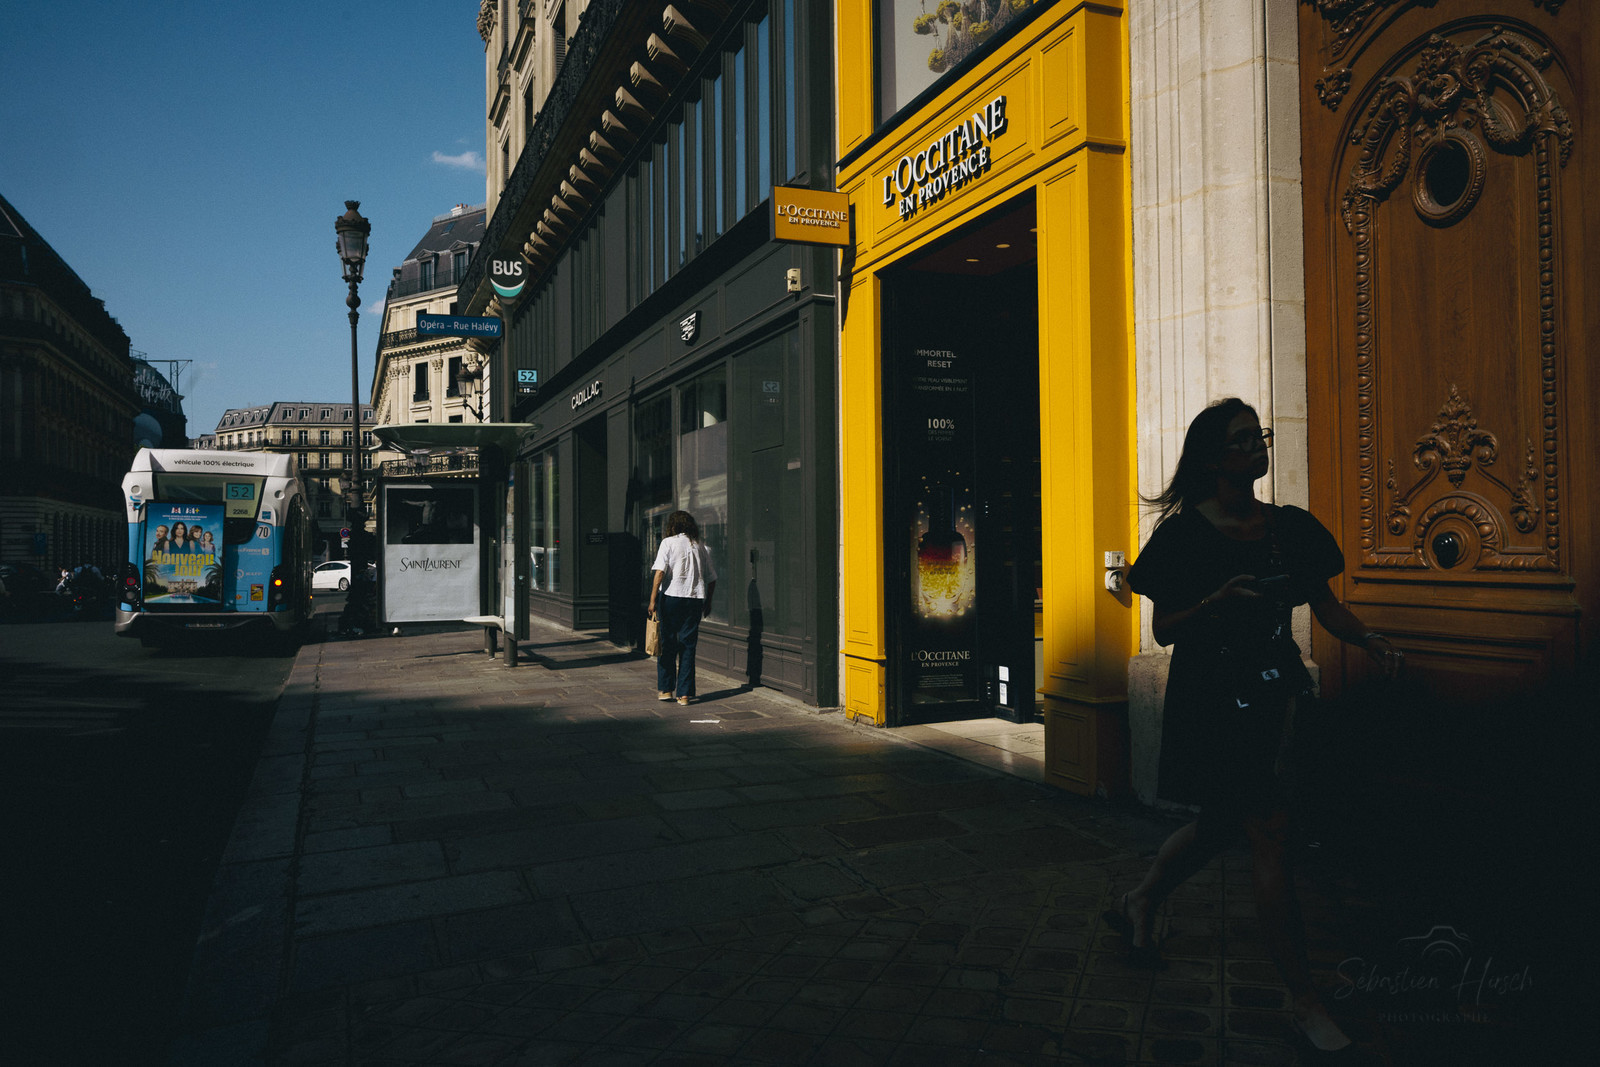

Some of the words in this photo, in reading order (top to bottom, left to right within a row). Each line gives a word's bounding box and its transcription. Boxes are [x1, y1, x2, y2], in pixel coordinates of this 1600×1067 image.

[883, 95, 1005, 205] L'OCCITANE
[898, 194, 915, 217] EN
[918, 146, 989, 205] PROVENCE
[777, 203, 848, 222] L'OCCITANE
[788, 216, 800, 224] EN
[801, 217, 840, 228] PROVENCE
[492, 260, 523, 276] BUS
[420, 319, 445, 332] Opéra
[453, 321, 469, 332] Rue
[471, 321, 498, 335] Halévy
[927, 360, 952, 368] RESET
[520, 371, 535, 381] 52
[571, 380, 600, 409] CADILLAC
[928, 418, 955, 429] 100%
[231, 486, 249, 498] 52
[258, 526, 269, 538] 70
[152, 550, 215, 566] Nouveau
[172, 564, 204, 577] Jour
